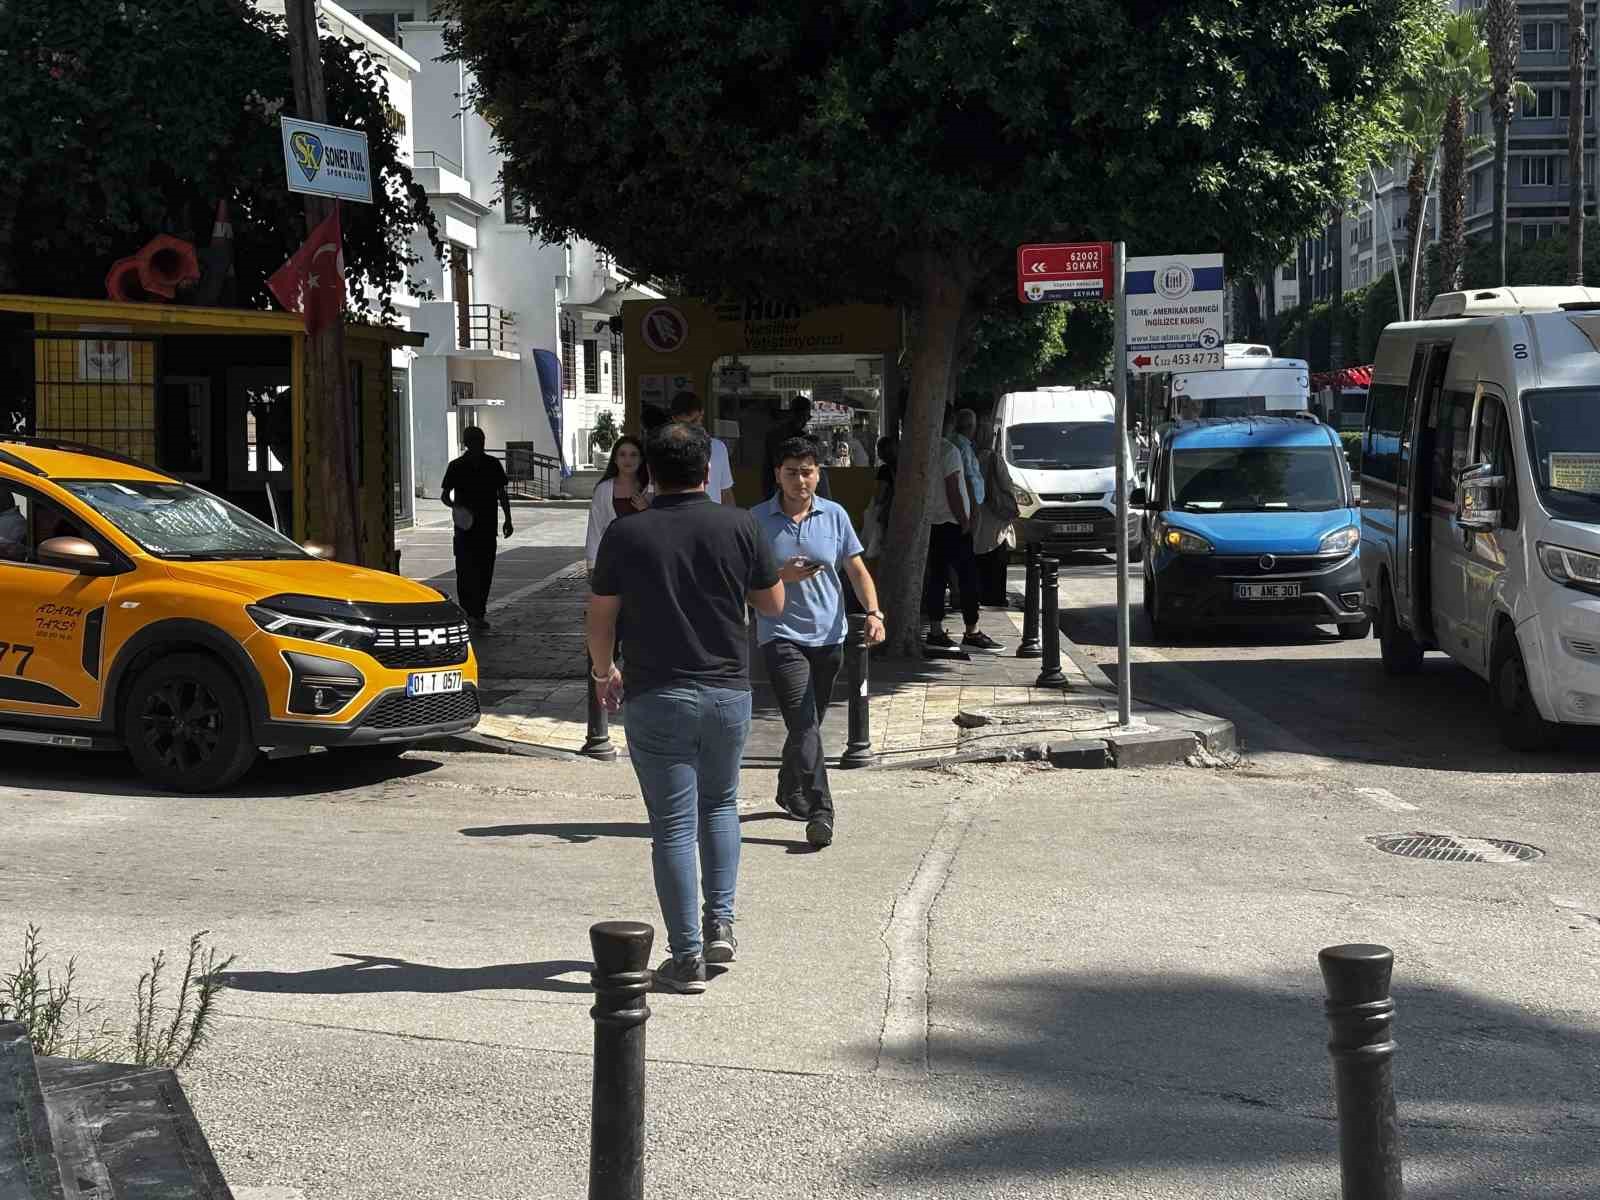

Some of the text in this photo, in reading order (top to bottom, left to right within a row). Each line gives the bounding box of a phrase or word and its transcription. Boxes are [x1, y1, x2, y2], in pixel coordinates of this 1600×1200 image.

[324, 145, 365, 172] SONER KUL
[1070, 251, 1099, 261] 62002
[1065, 261, 1099, 271] SOKAK
[1180, 317, 1204, 325] KURSU
[1171, 353, 1190, 365] 453
[1192, 352, 1205, 363] 47
[1207, 351, 1219, 363] 73
[1240, 585, 1252, 597] 01
[1281, 584, 1299, 597] 301
[36, 603, 82, 617] ADANA
[414, 672, 462, 693] 01 T 0577
